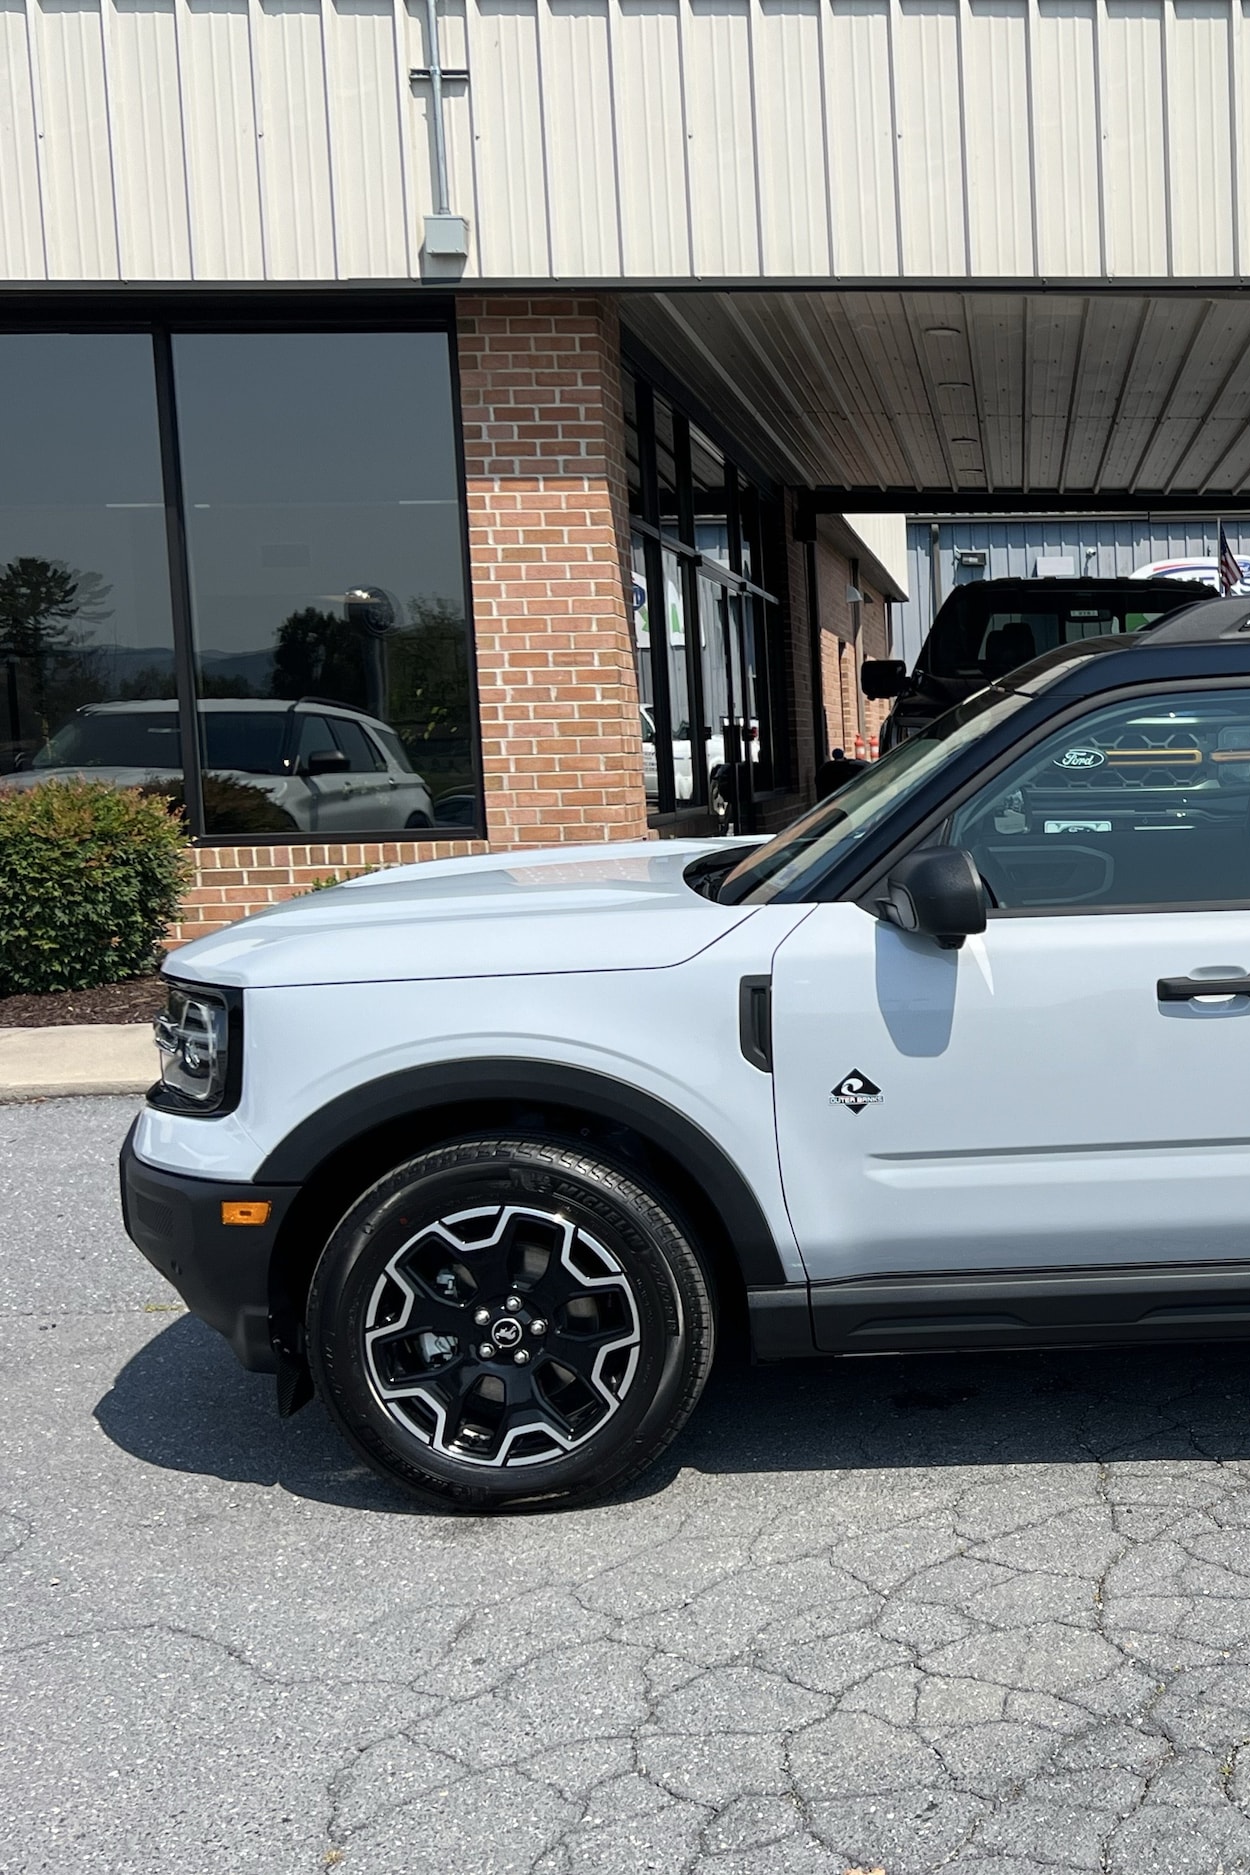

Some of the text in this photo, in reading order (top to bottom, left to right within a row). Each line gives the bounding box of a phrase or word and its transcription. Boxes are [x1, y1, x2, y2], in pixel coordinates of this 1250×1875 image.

[1061, 749, 1095, 767] Ford
[829, 1096, 883, 1104] OUTER BANKS
[555, 1181, 648, 1252] MICHELIN
